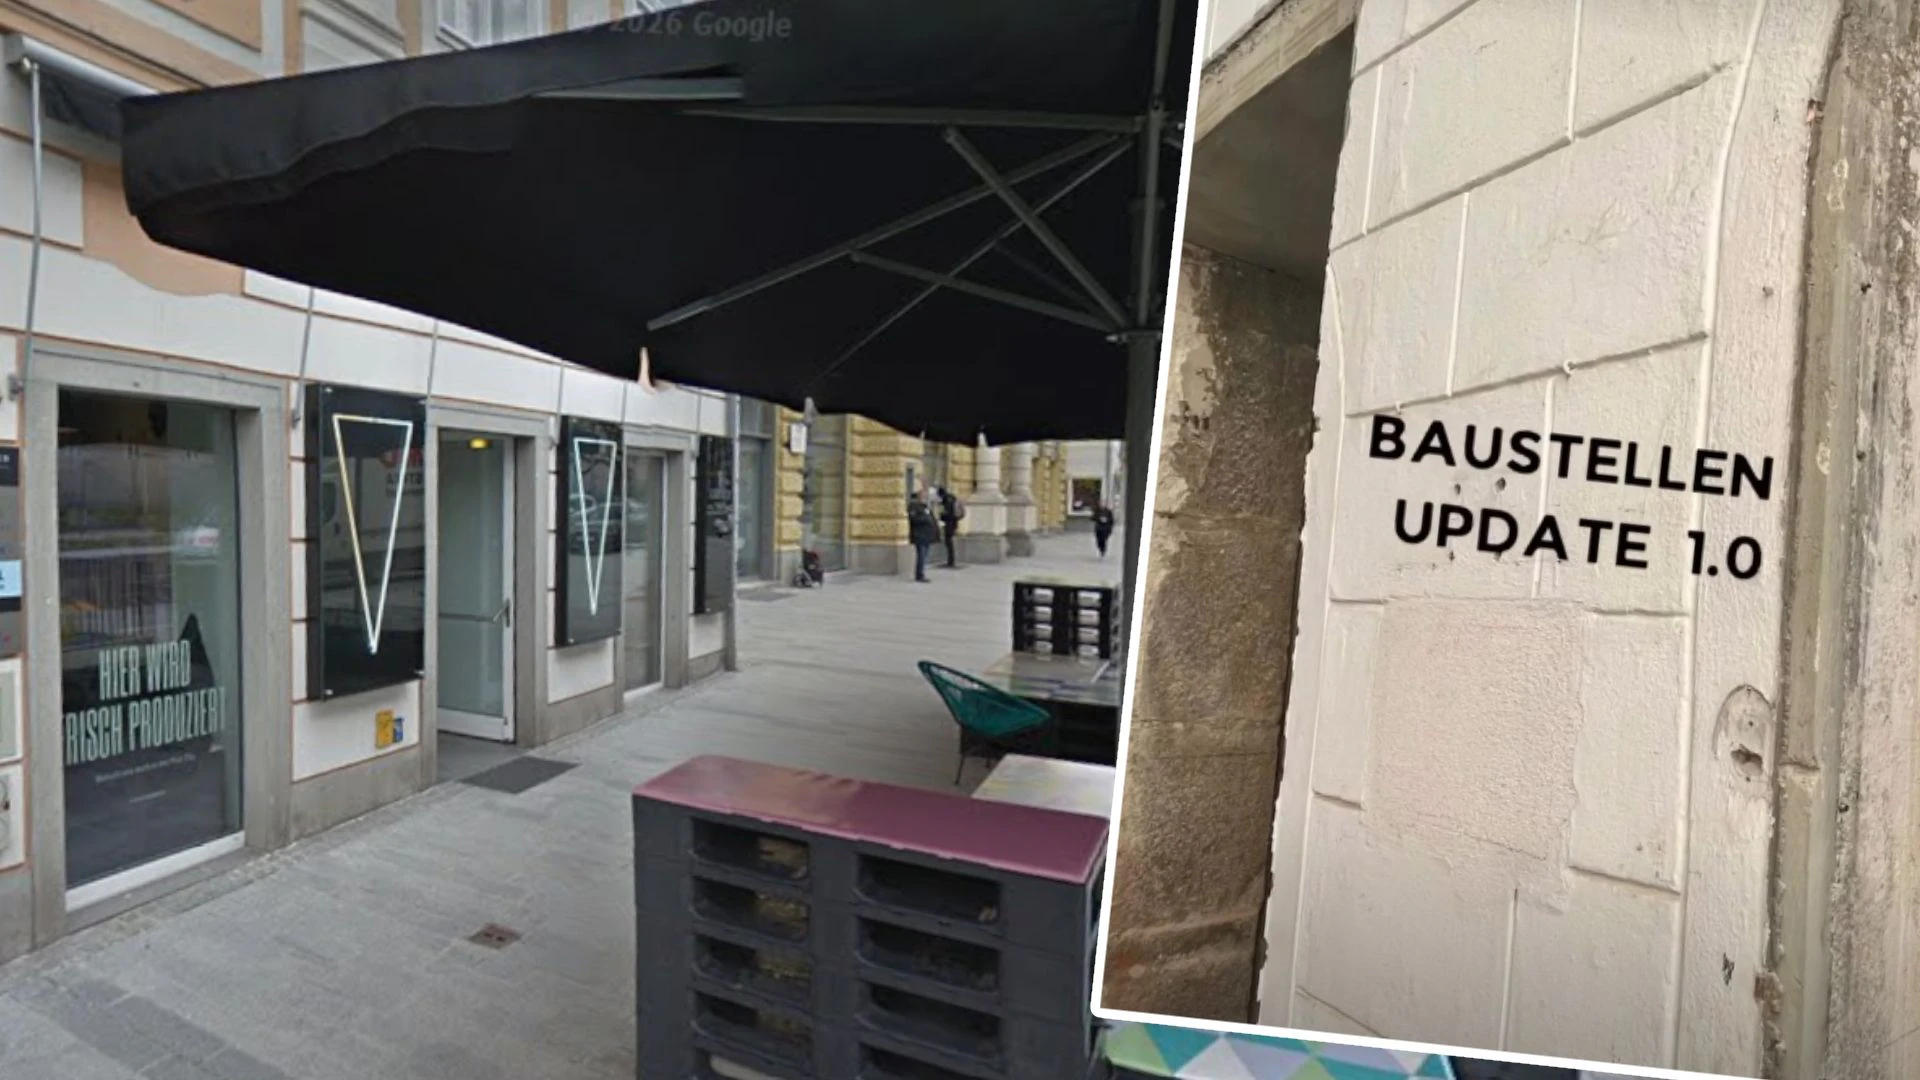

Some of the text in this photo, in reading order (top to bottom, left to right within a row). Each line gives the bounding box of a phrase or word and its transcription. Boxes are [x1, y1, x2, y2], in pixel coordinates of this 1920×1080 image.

[99, 640, 192, 700] HIER WIRD
[63, 687, 226, 766] RISCH PRODUZIERT
